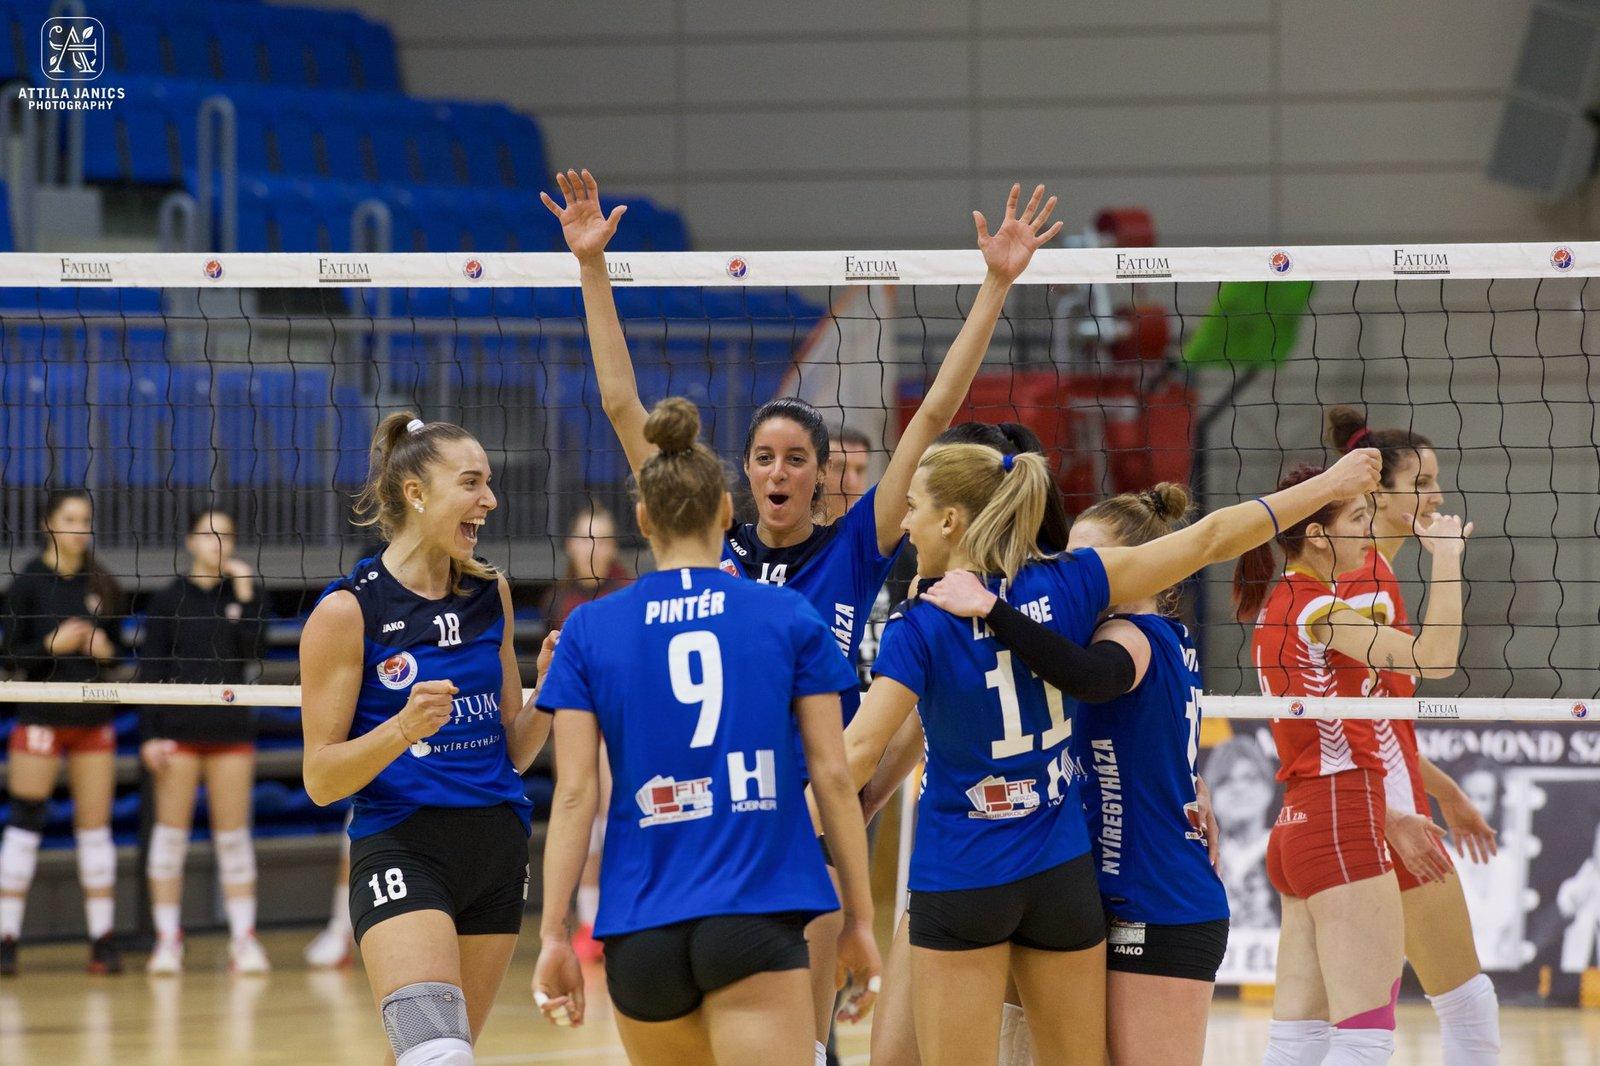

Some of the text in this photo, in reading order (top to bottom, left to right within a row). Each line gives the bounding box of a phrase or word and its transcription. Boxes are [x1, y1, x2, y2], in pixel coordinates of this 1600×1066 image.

[756, 562, 788, 588] 14
[645, 588, 725, 625] PINTÉR
[382, 620, 406, 634] JAKO
[432, 612, 462, 647] 18
[668, 630, 723, 749] 9
[984, 649, 1072, 760] 11
[451, 692, 498, 718] TUM
[675, 780, 709, 796] FIT
[1006, 780, 1035, 796] FIT
[1090, 738, 1123, 876] NYÍREGYHÁZA
[368, 867, 408, 907] 18
[1113, 944, 1144, 956] JAKO
